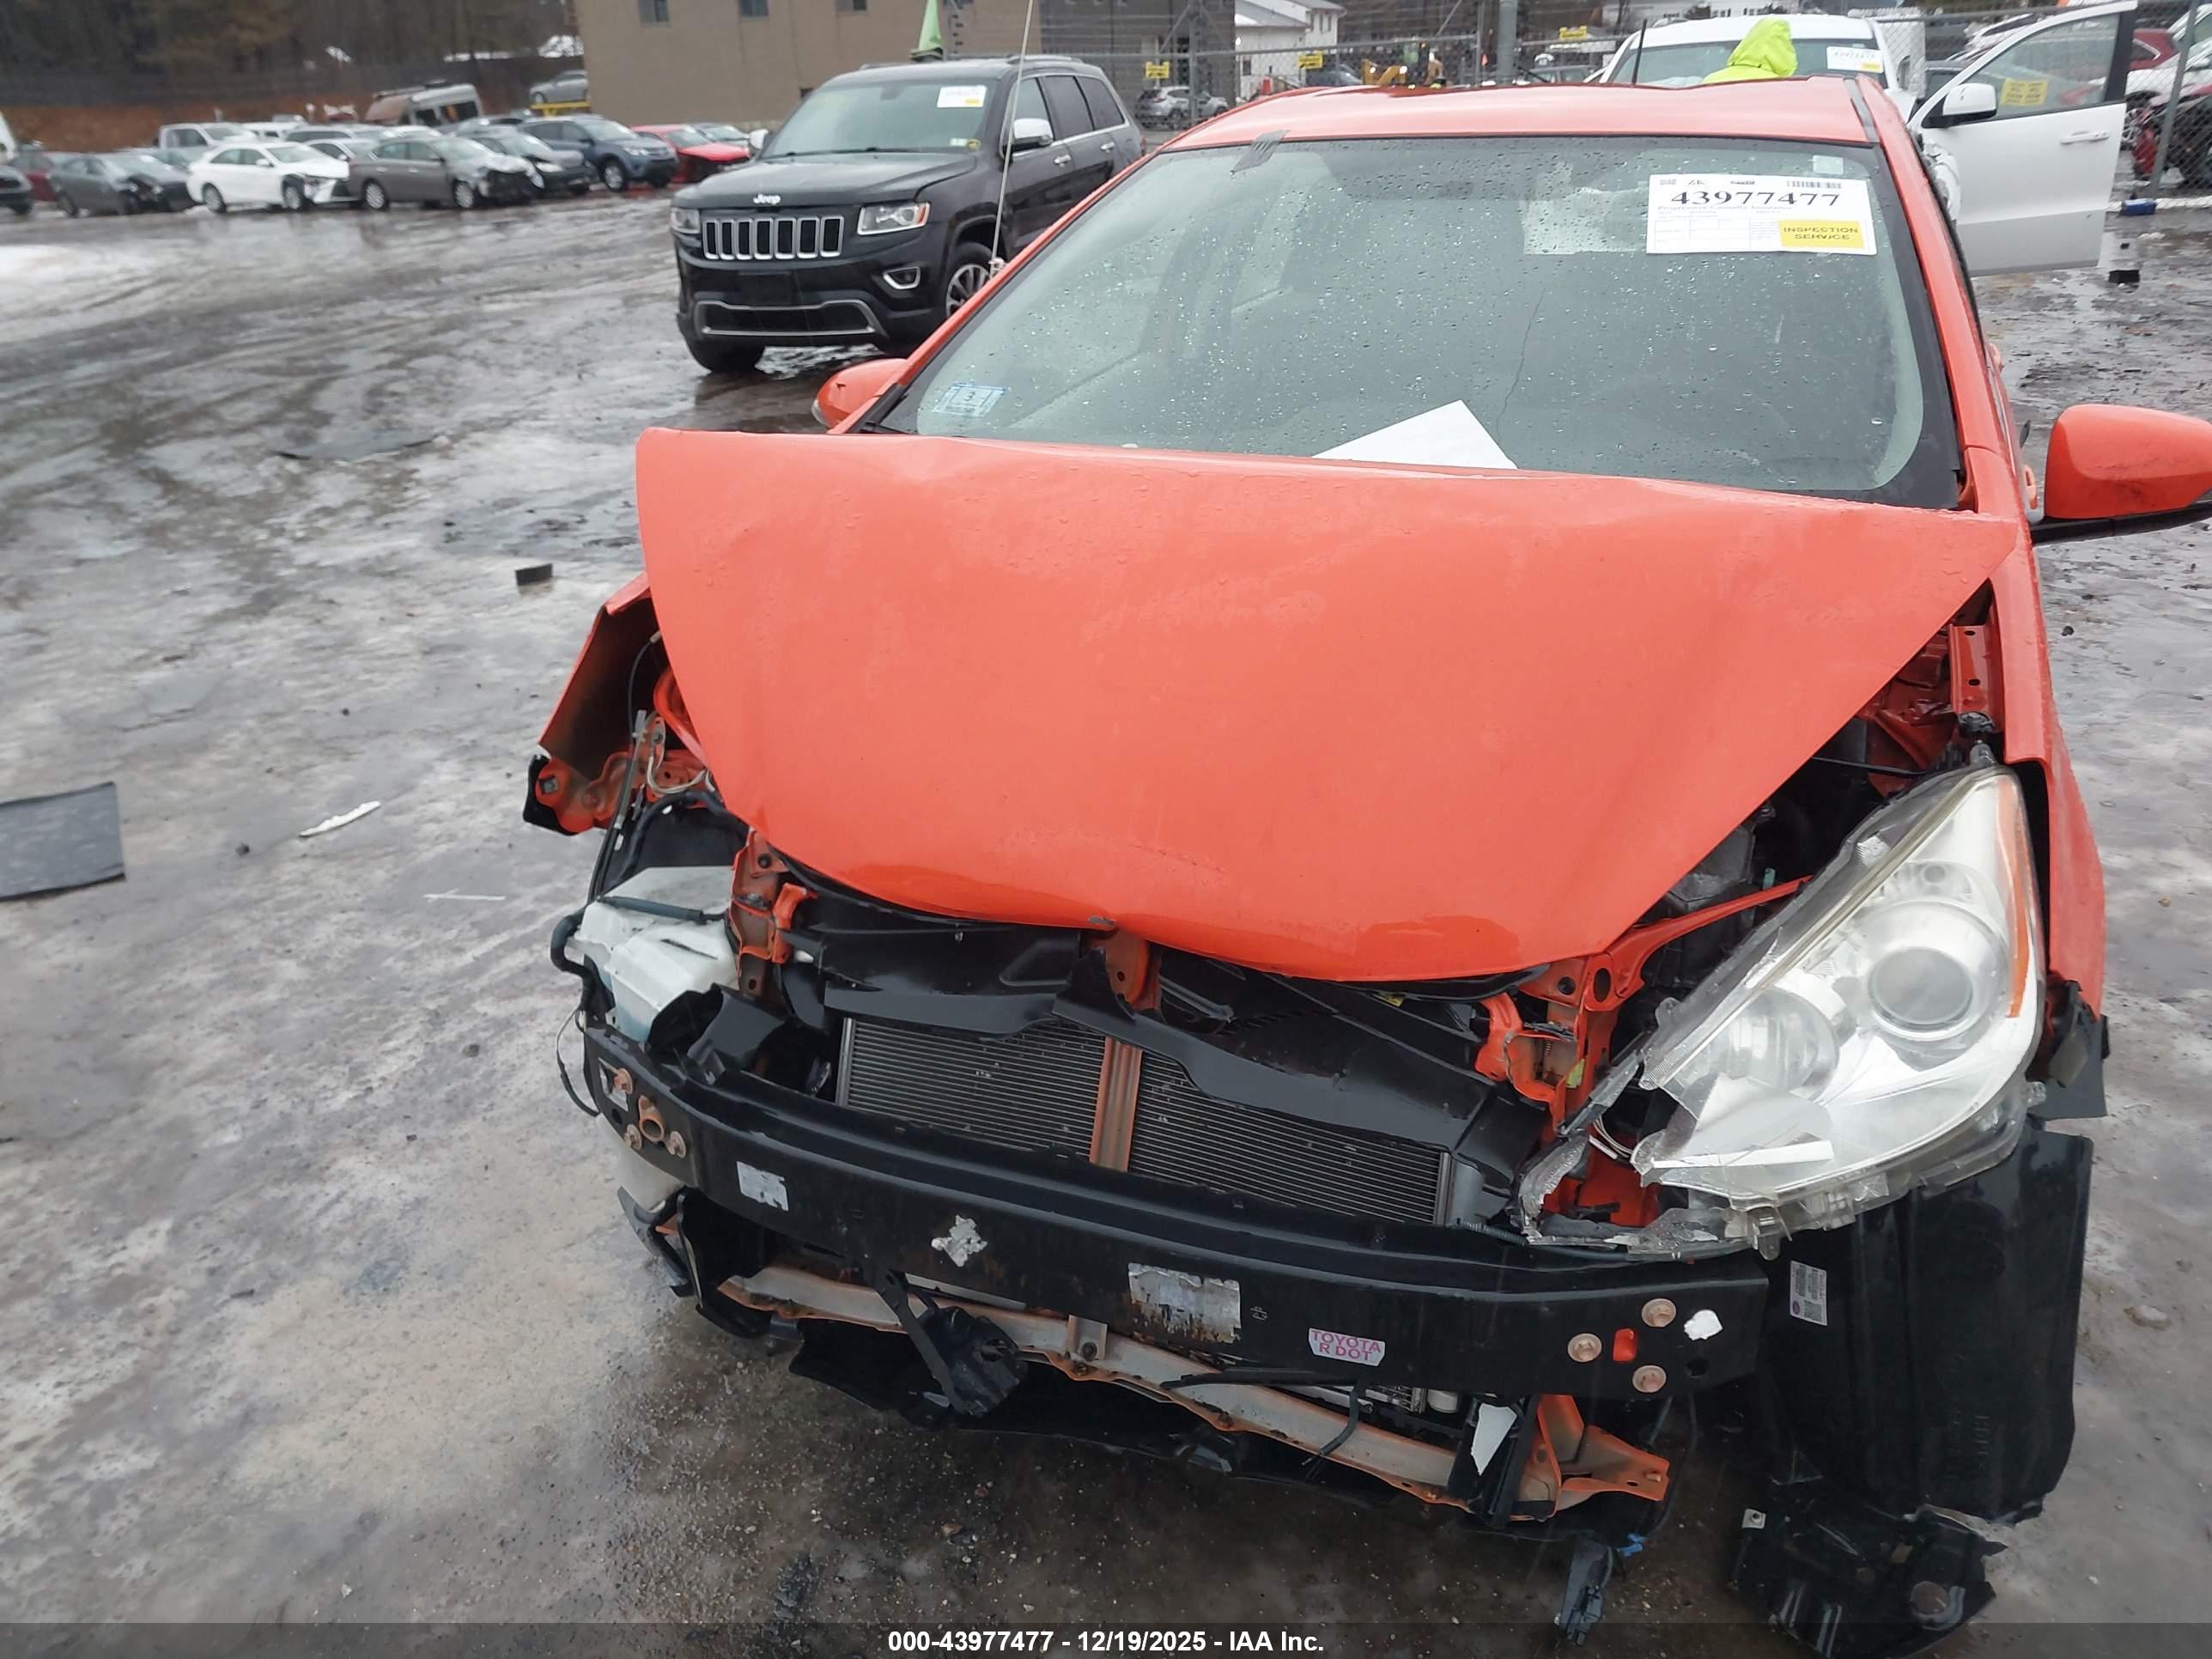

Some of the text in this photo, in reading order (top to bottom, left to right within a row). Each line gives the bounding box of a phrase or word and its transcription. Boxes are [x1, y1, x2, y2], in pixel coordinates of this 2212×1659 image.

[1671, 191, 1839, 206] 43977477
[1311, 1329, 1382, 1352] TOYOTA
[1319, 1342, 1372, 1361] R DOT
